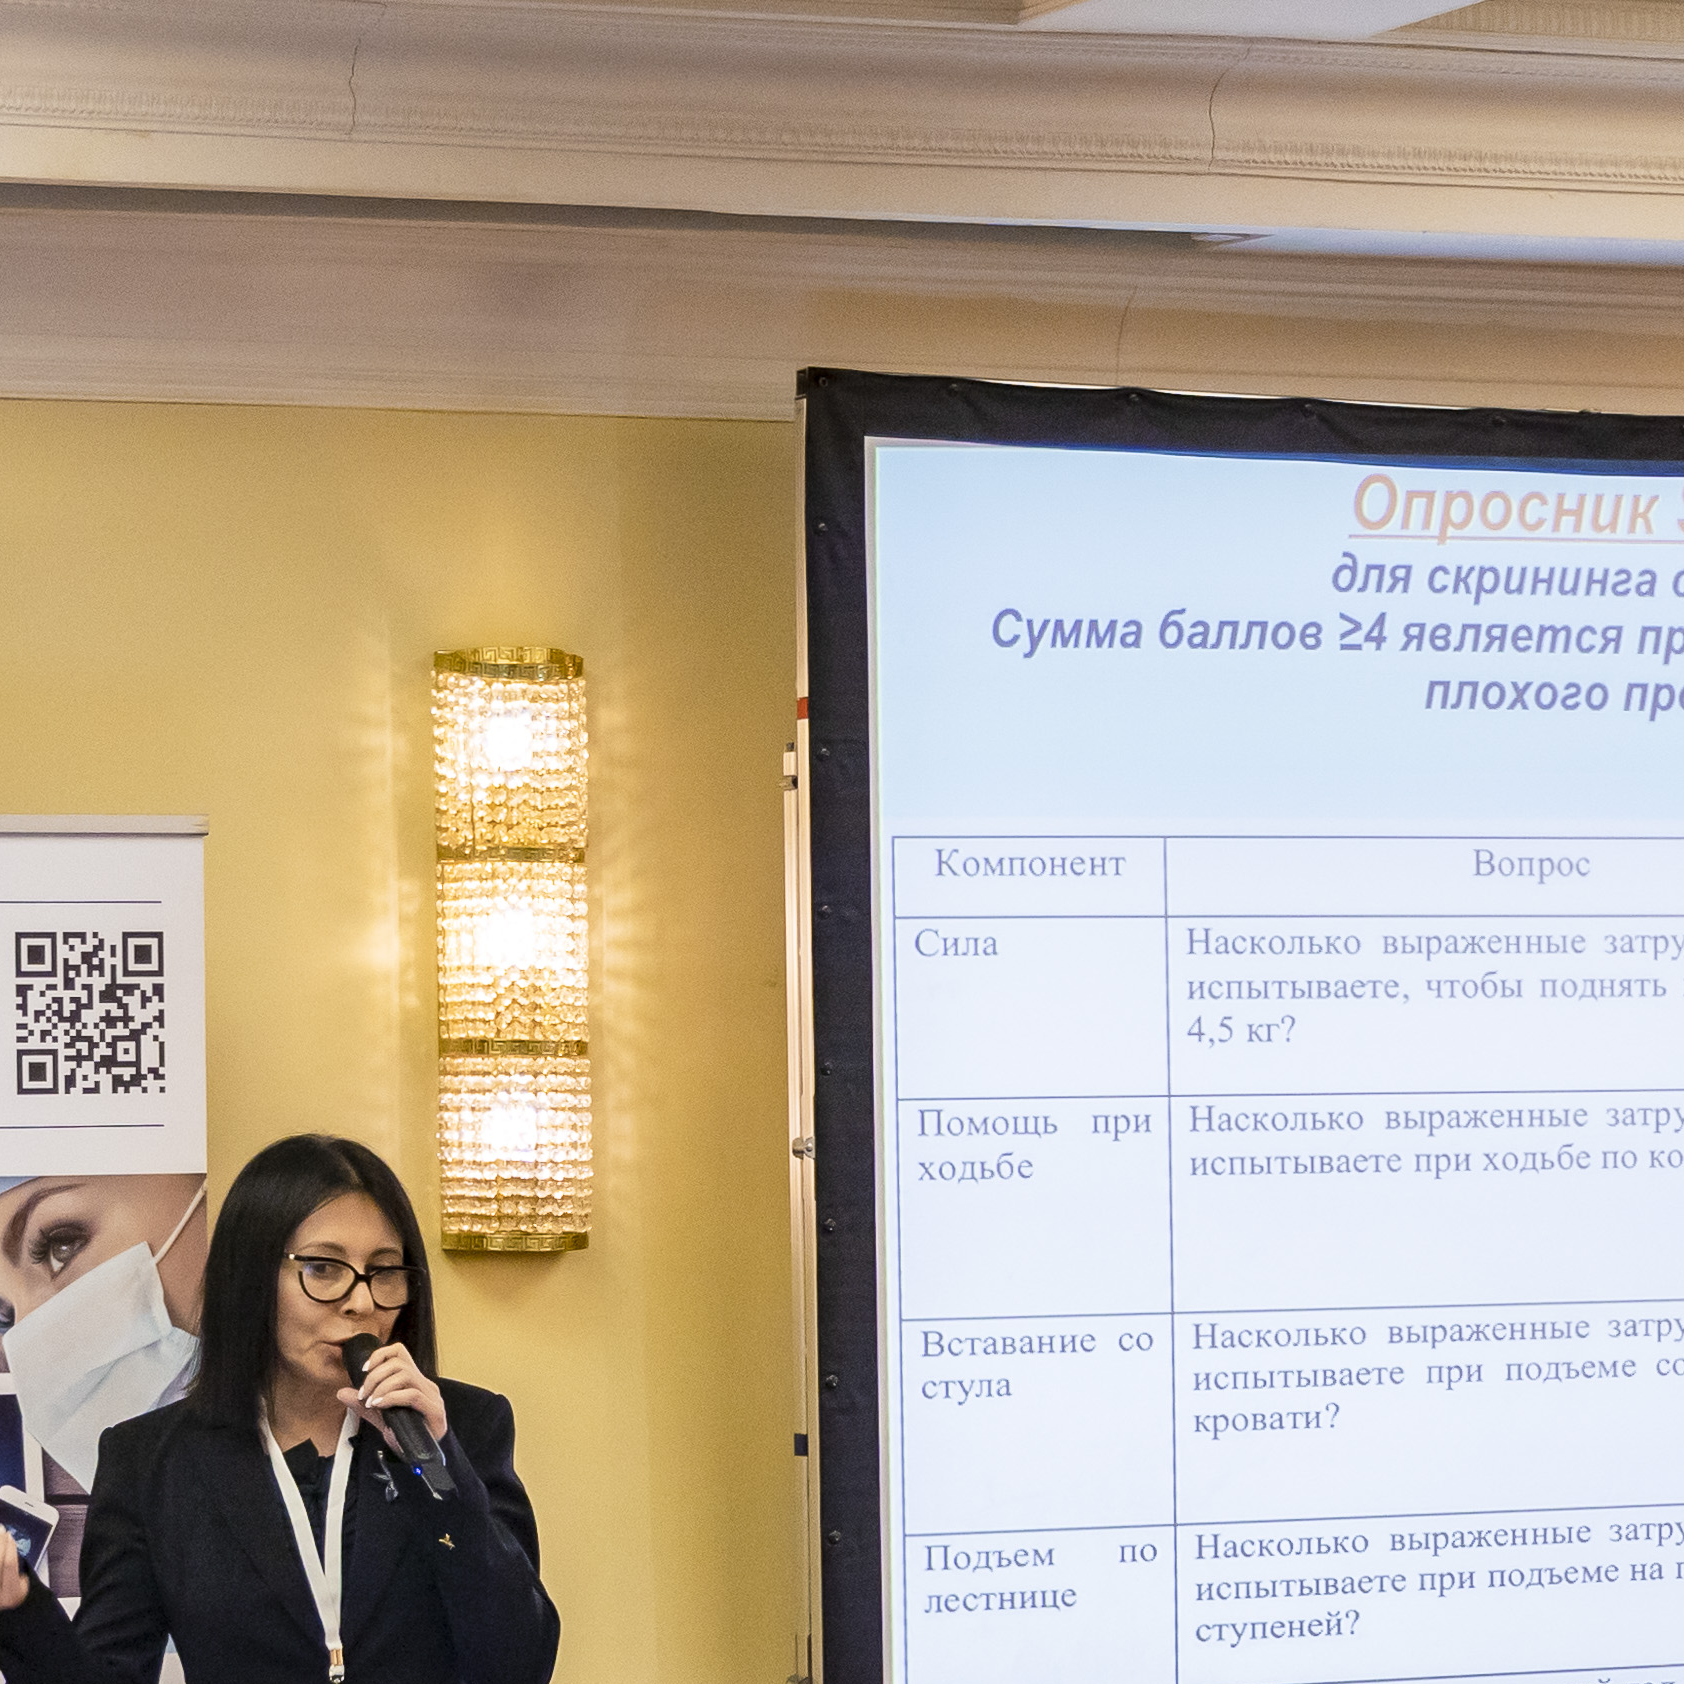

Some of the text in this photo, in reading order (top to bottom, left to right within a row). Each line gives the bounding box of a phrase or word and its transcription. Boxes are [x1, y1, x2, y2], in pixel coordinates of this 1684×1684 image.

[1354, 474, 1660, 545] Опросник
[1331, 550, 1413, 594] для
[1427, 564, 1658, 606] скрининга
[991, 607, 1143, 659] Сумма
[1158, 607, 1323, 651] баллов
[1338, 611, 1388, 652] ≥4
[1399, 622, 1624, 655] является
[1424, 679, 1610, 712] плохого
[935, 848, 1127, 878] Компонент
[1473, 848, 1591, 885] Вопрос
[914, 927, 999, 958] Сила
[1186, 927, 1362, 956] Насколько
[1382, 934, 1587, 962] выраженные
[1187, 979, 1410, 1002] испытываете,
[1425, 970, 1523, 1000] чтобы
[1540, 978, 1668, 1001] поднять
[1186, 1014, 1297, 1048] 4,5 кг?
[917, 1108, 1152, 1142] Помощь при
[1189, 1104, 1364, 1133] Насколько
[1385, 1107, 1589, 1138] выраженные
[917, 1151, 1034, 1184] ходьбе
[1190, 1153, 1402, 1177] испытываете
[1414, 1152, 1472, 1180] при
[1482, 1142, 1592, 1174] ходьбе
[1601, 1149, 1638, 1170] по
[921, 1330, 1154, 1358] Вставание со
[1192, 1322, 1367, 1350] Насколько
[1387, 1319, 1591, 1350] выраженные
[921, 1377, 1013, 1407] стула
[1193, 1366, 1405, 1392] испытываете
[1426, 1363, 1483, 1391] при
[1505, 1359, 1637, 1383] подъеме
[1193, 1401, 1341, 1441] кровати?
[924, 1543, 1158, 1573] Подъем по
[1195, 1533, 1370, 1560] Насколько
[1389, 1525, 1592, 1558] выраженные
[1195, 1573, 1407, 1602] испытываете
[1418, 1570, 1476, 1598] при
[1487, 1563, 1620, 1589] подъеме
[1630, 1562, 1665, 1582] на
[923, 1588, 1077, 1614] лестнице
[1195, 1609, 1361, 1649] ступеней?
